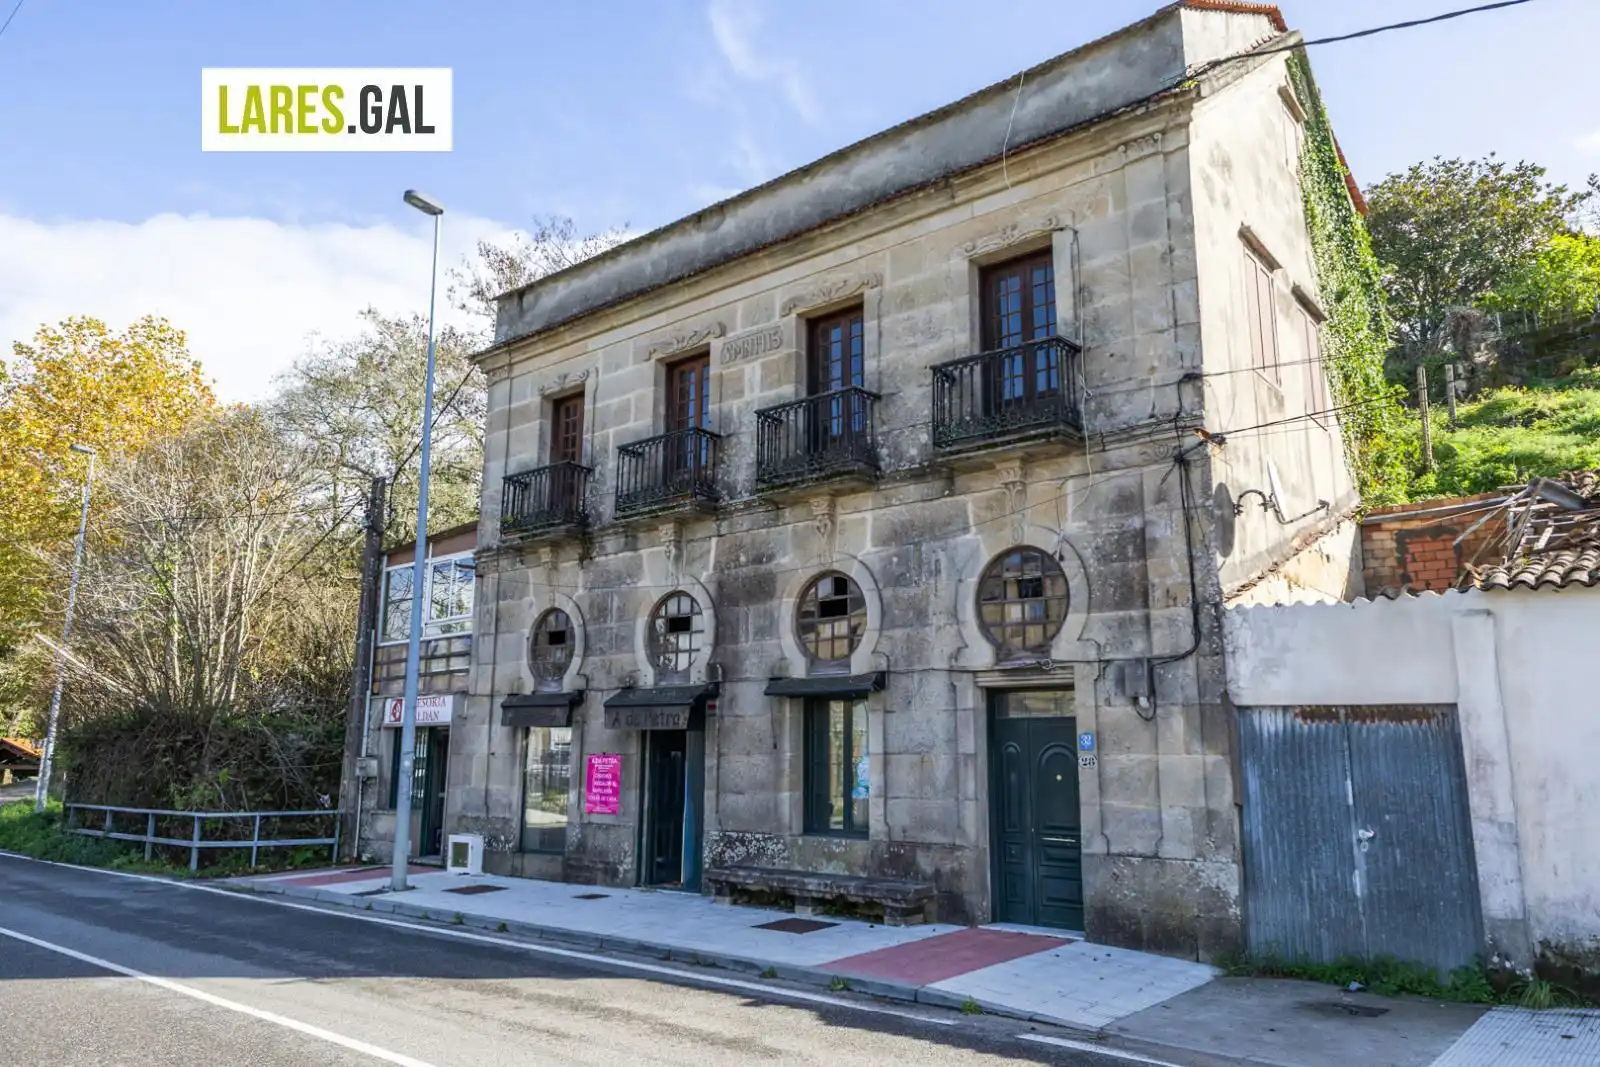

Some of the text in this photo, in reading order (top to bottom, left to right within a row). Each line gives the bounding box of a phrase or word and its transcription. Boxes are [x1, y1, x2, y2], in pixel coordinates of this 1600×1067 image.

[415, 710, 440, 720] LDAN
[611, 710, 622, 729] A
[645, 707, 681, 728] Petra
[1080, 734, 1091, 745] 32
[1081, 757, 1095, 767] 28
